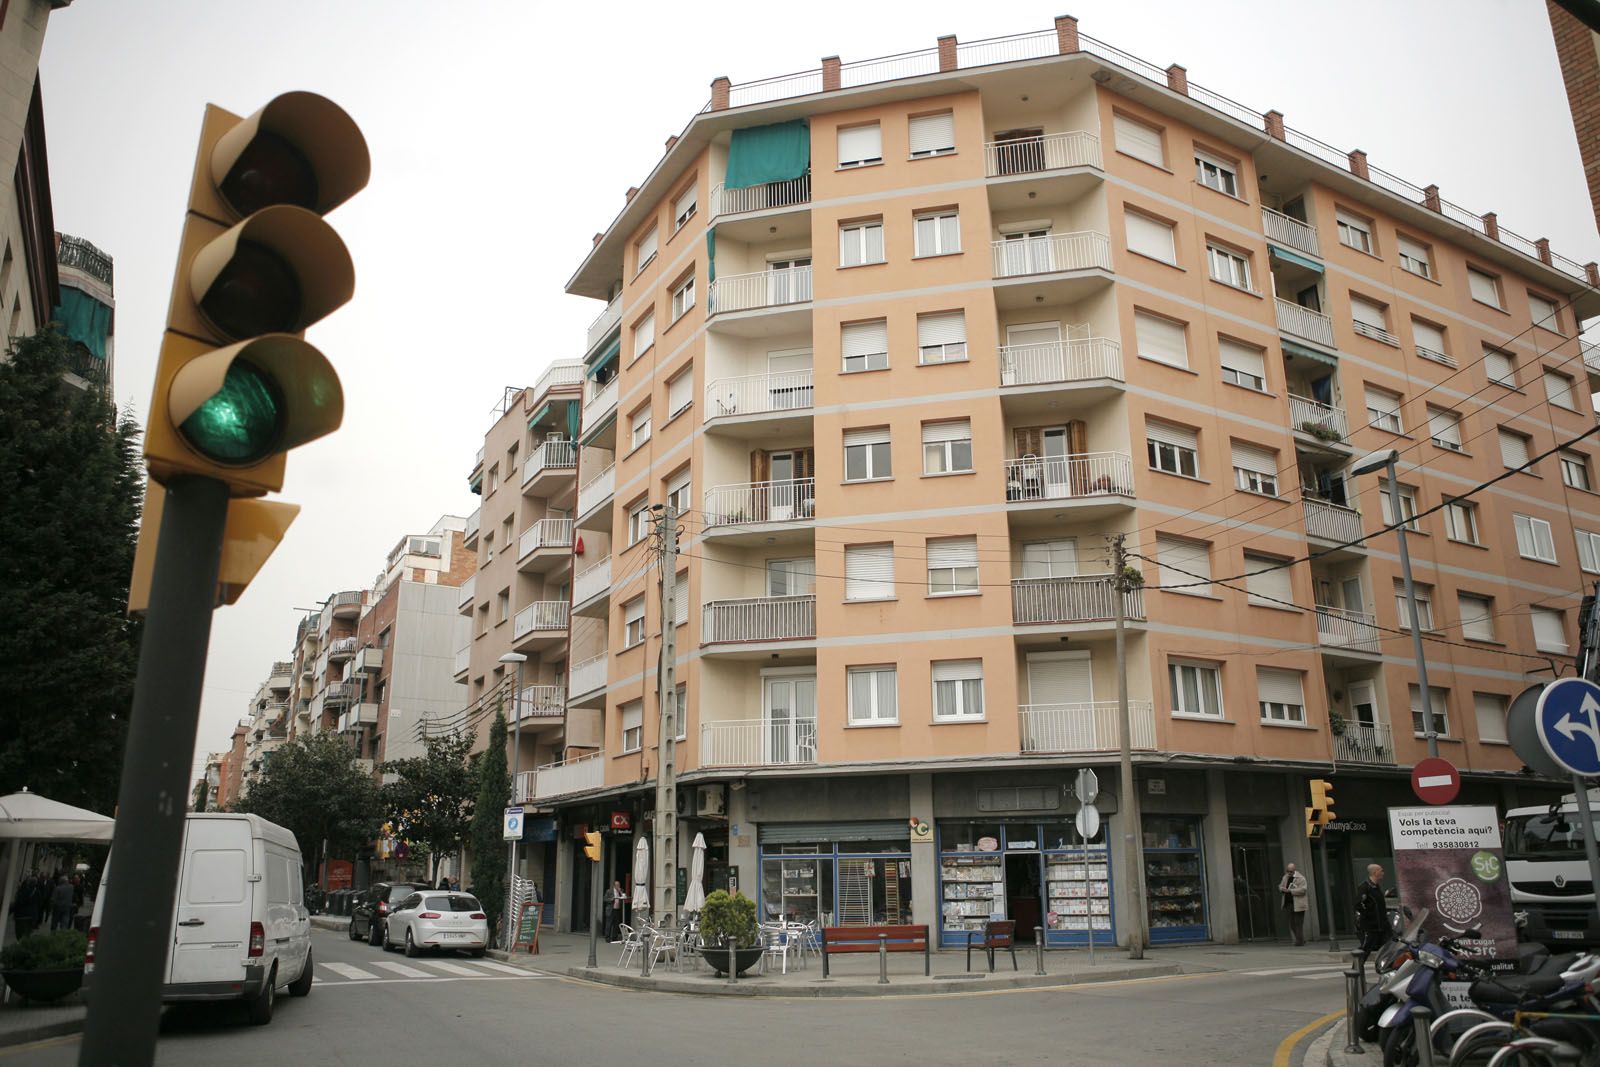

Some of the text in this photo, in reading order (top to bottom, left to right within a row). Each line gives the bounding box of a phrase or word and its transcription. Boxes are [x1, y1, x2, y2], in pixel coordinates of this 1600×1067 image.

[614, 815, 628, 825] CX
[1399, 817, 1456, 827] Vols la teva
